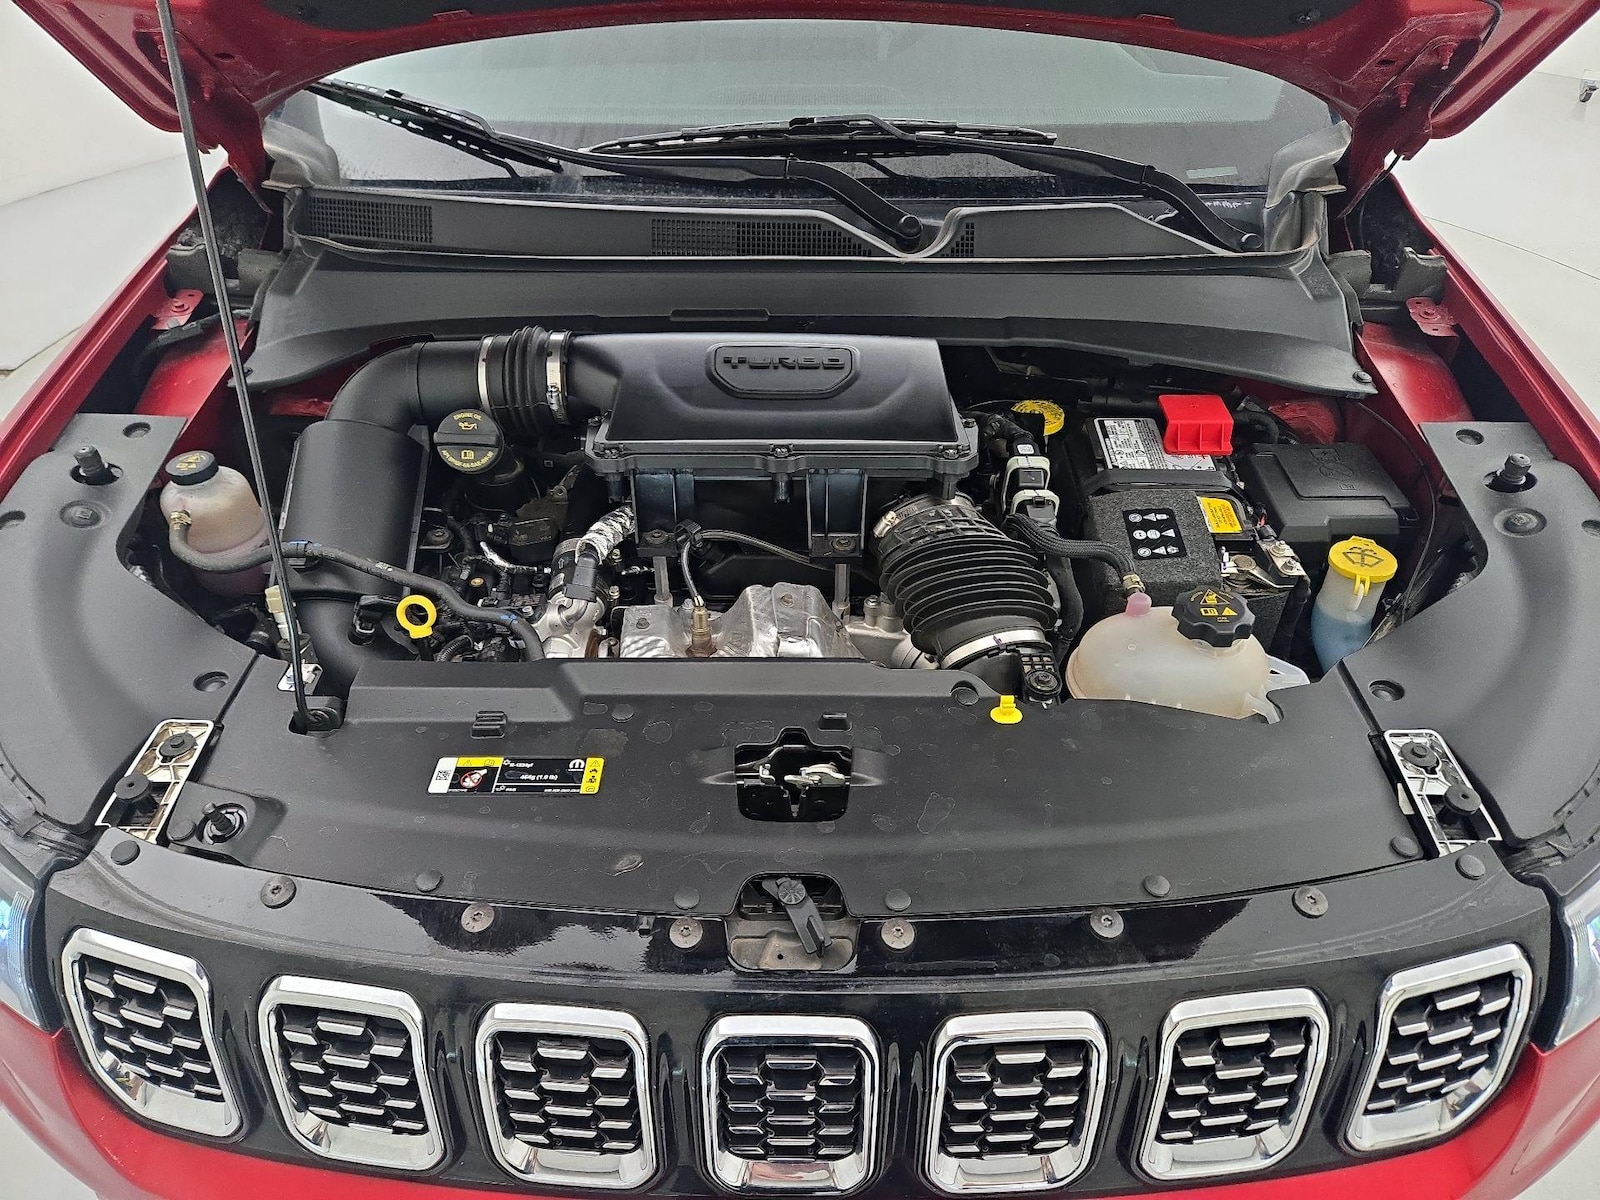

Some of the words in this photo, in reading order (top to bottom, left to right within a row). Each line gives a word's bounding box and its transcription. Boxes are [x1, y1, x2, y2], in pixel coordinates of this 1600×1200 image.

[723, 355, 846, 370] TURBO
[453, 412, 473, 421] ENGINE
[473, 412, 483, 422] OIL
